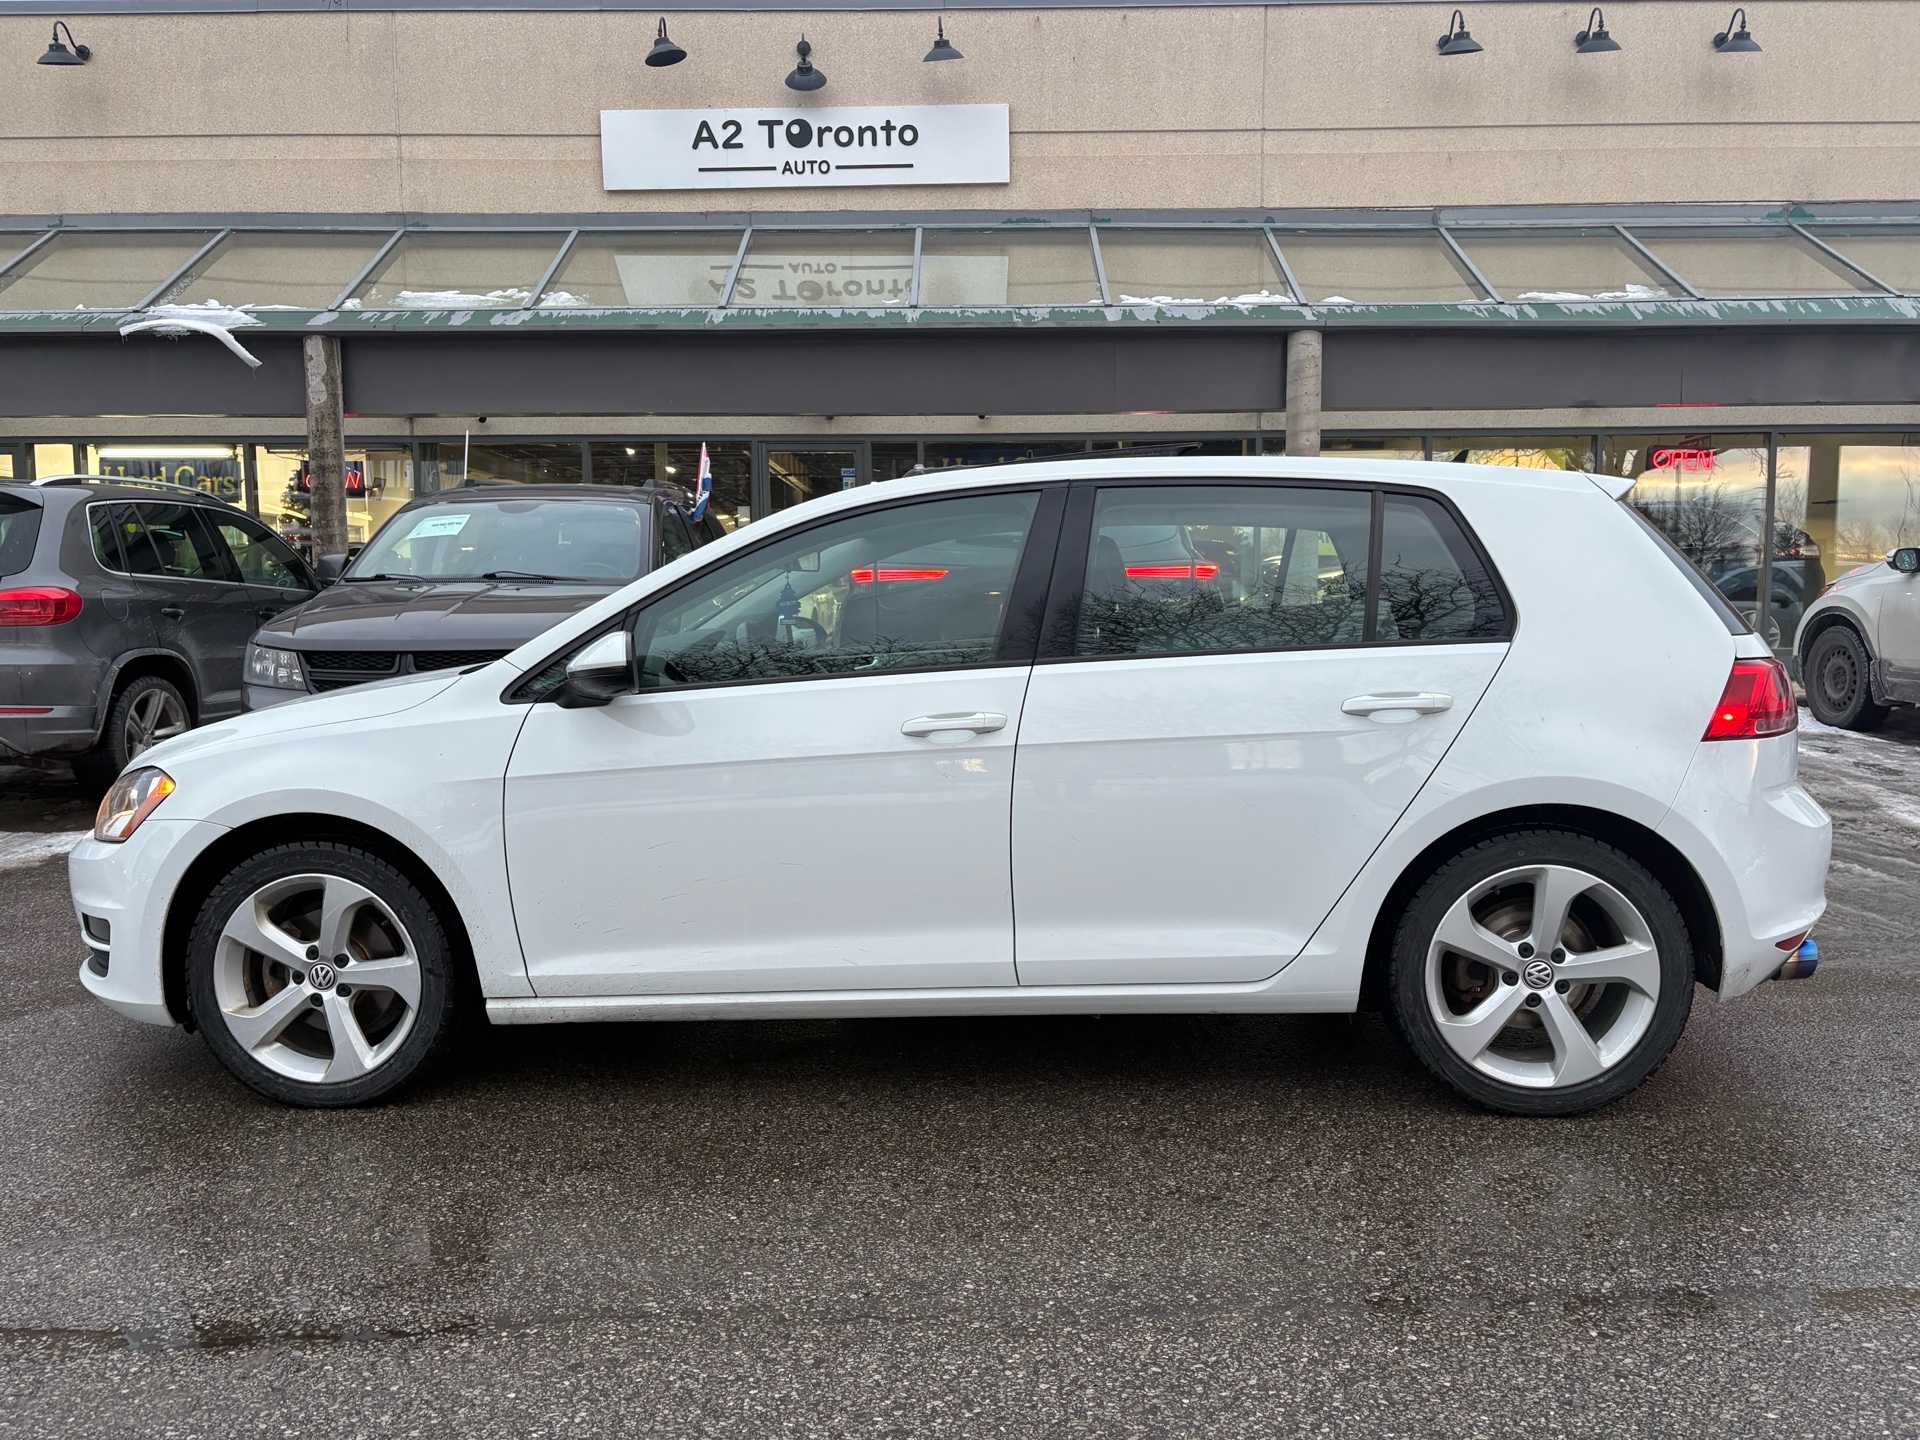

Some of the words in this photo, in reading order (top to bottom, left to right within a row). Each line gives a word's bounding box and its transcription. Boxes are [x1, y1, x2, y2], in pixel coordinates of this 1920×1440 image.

[692, 120, 743, 149] A2
[781, 160, 831, 175] AUTO
[1653, 449, 1714, 471] OPEN
[175, 465, 235, 495] Cars
